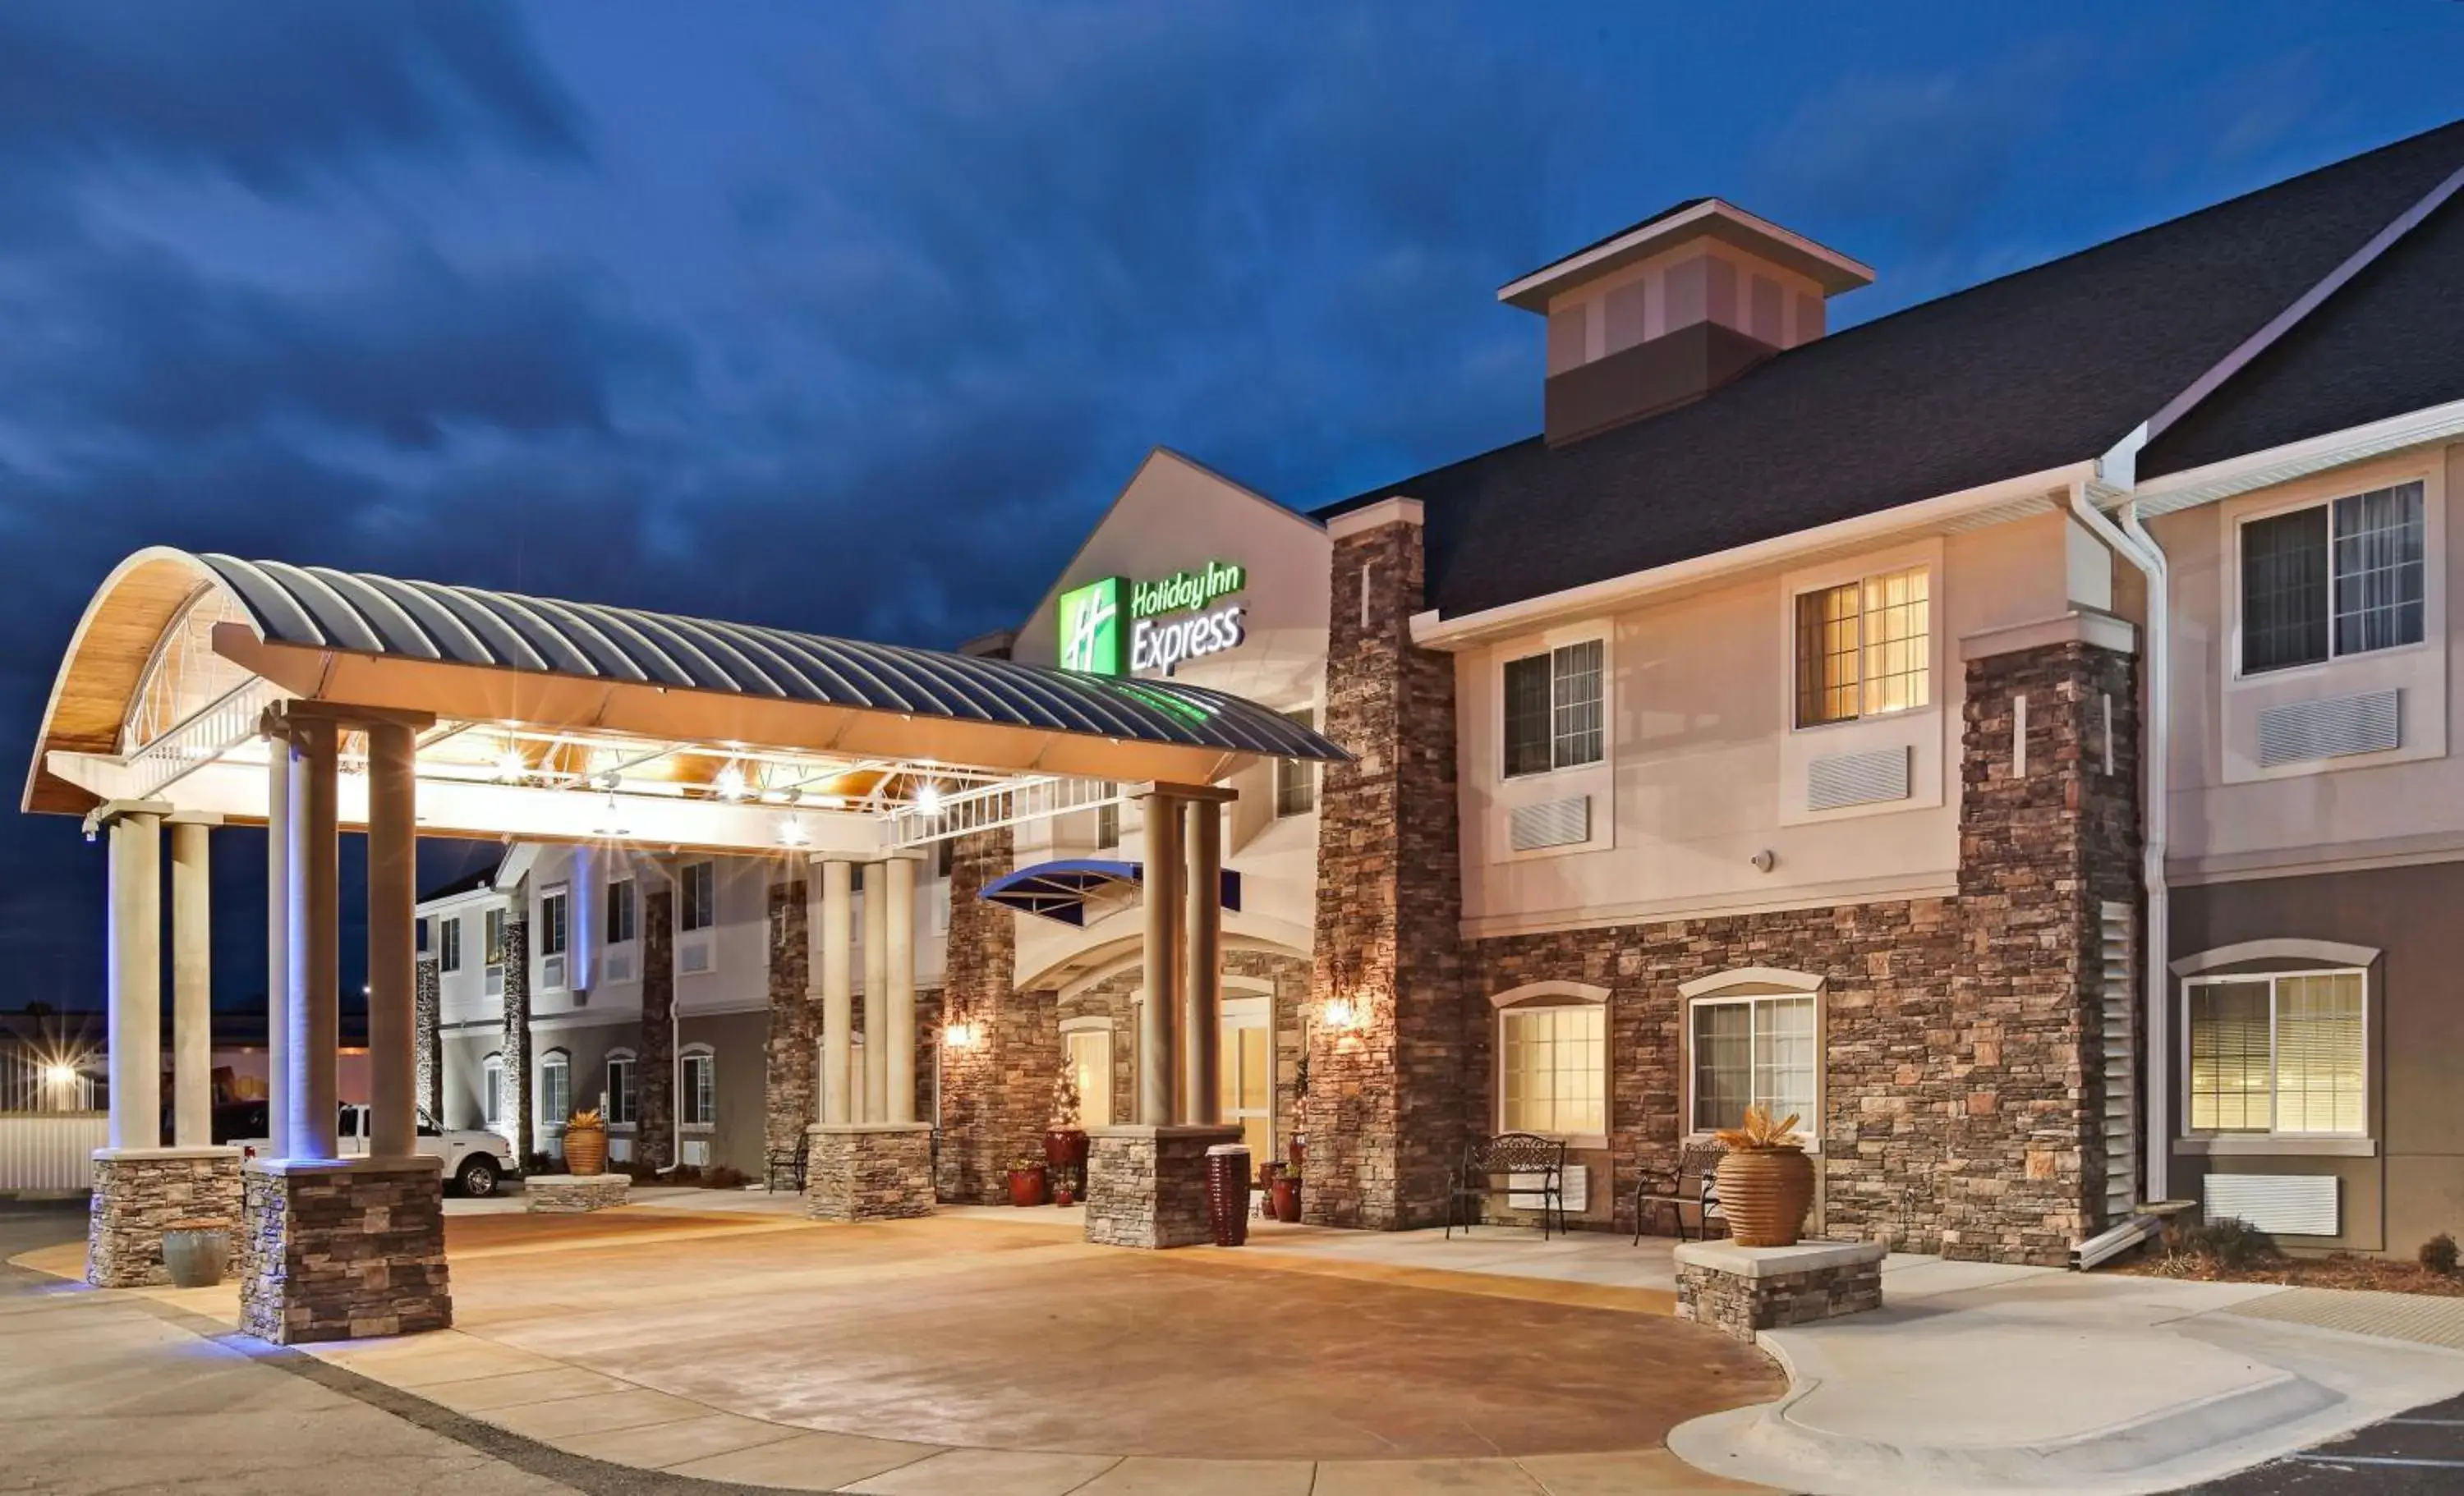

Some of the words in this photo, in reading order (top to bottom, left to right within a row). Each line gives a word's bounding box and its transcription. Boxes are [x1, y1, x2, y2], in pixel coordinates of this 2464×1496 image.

[1132, 572, 1207, 618] Holiday
[1206, 561, 1241, 598] Inn
[1131, 606, 1243, 677] Express
